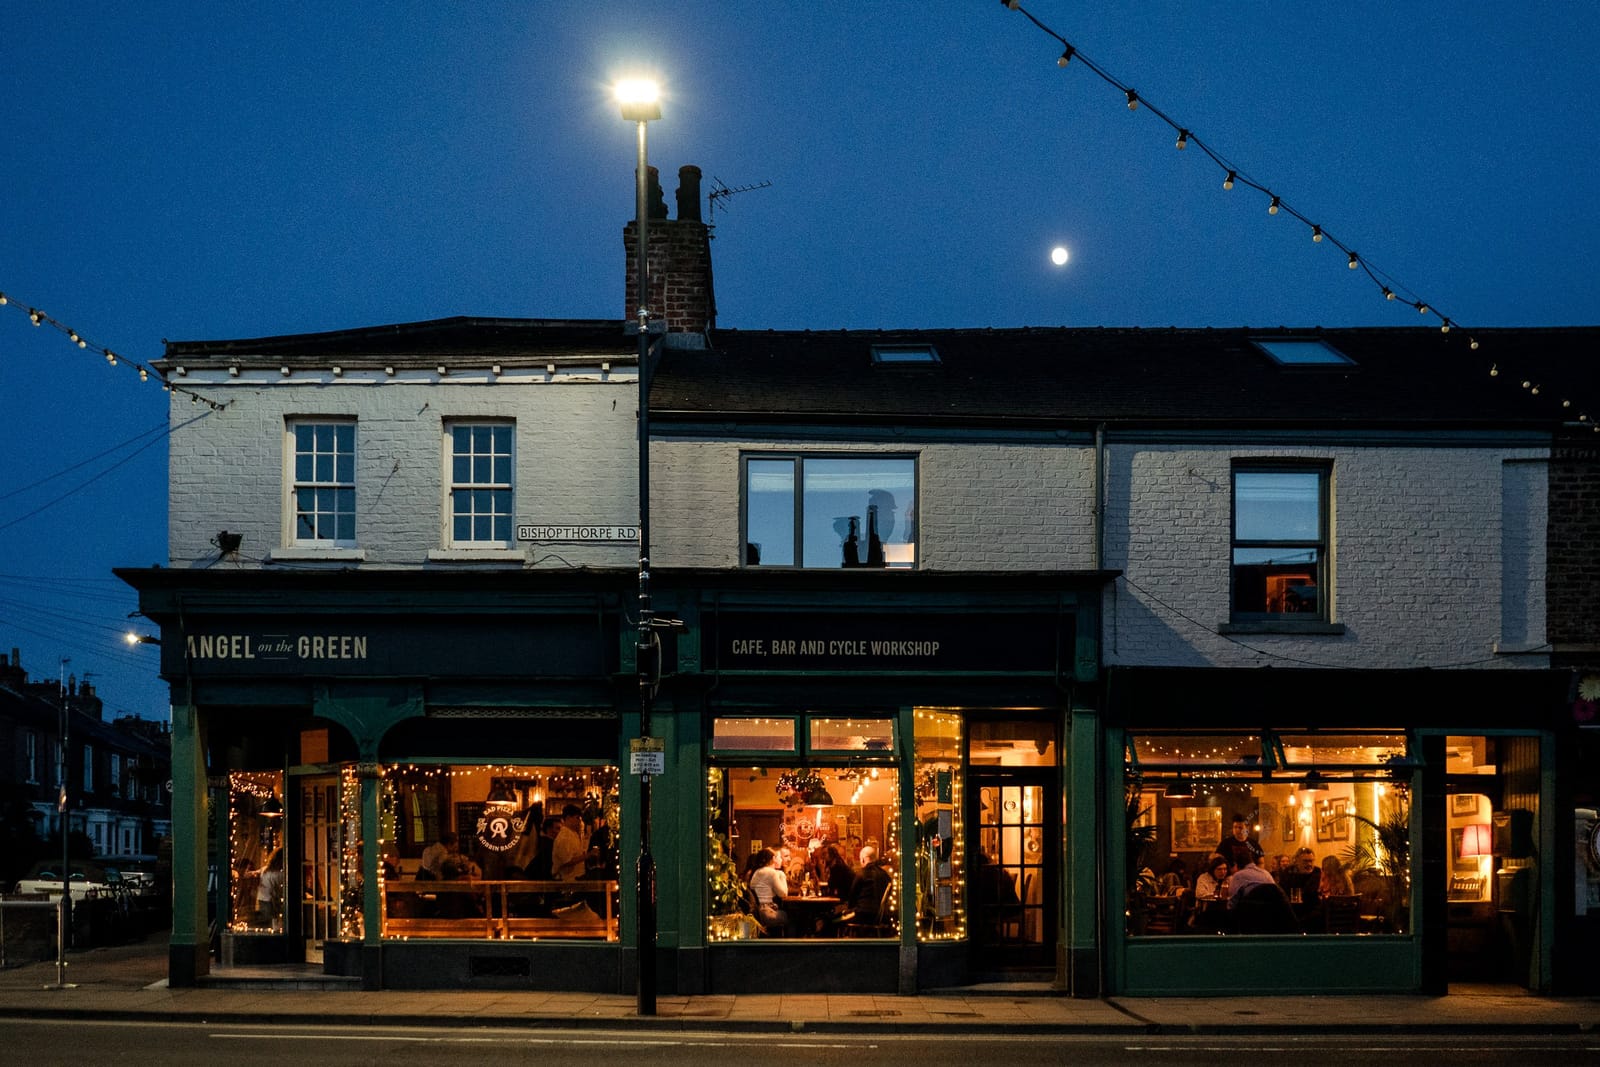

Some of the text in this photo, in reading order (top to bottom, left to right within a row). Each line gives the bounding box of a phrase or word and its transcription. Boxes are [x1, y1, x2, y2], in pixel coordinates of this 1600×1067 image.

[520, 527, 612, 539] BISHOPTHORPE
[184, 635, 367, 659] ANGEL on the GREEN
[732, 639, 940, 656] CAFE, BAR AND CYCLE WORKSHOP
